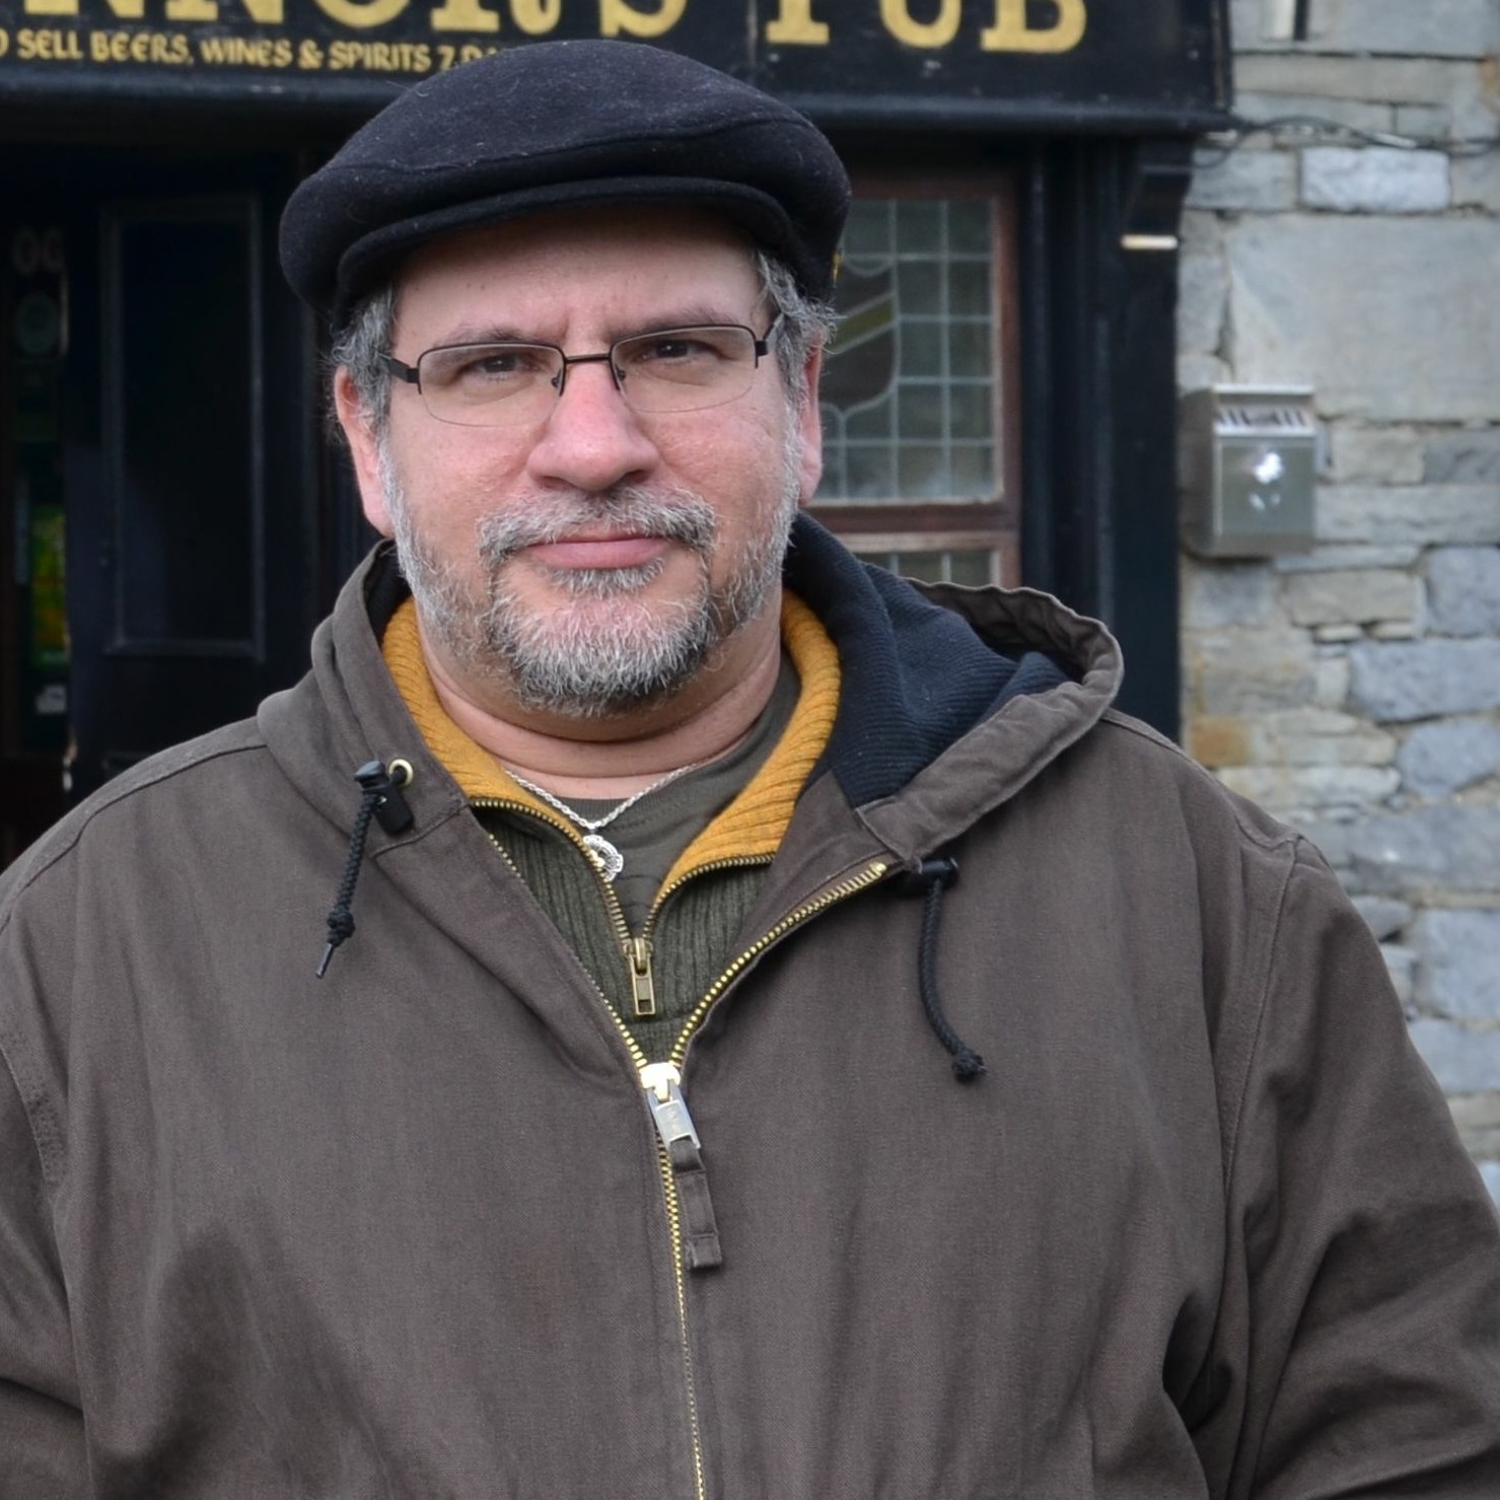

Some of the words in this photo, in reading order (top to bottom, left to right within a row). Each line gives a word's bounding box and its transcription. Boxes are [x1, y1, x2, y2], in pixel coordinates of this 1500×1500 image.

[16, 28, 84, 60] SELL
[89, 30, 194, 65] BEERS,
[199, 36, 293, 68] WINES
[298, 39, 325, 70] &
[328, 40, 432, 73] SPIRITS
